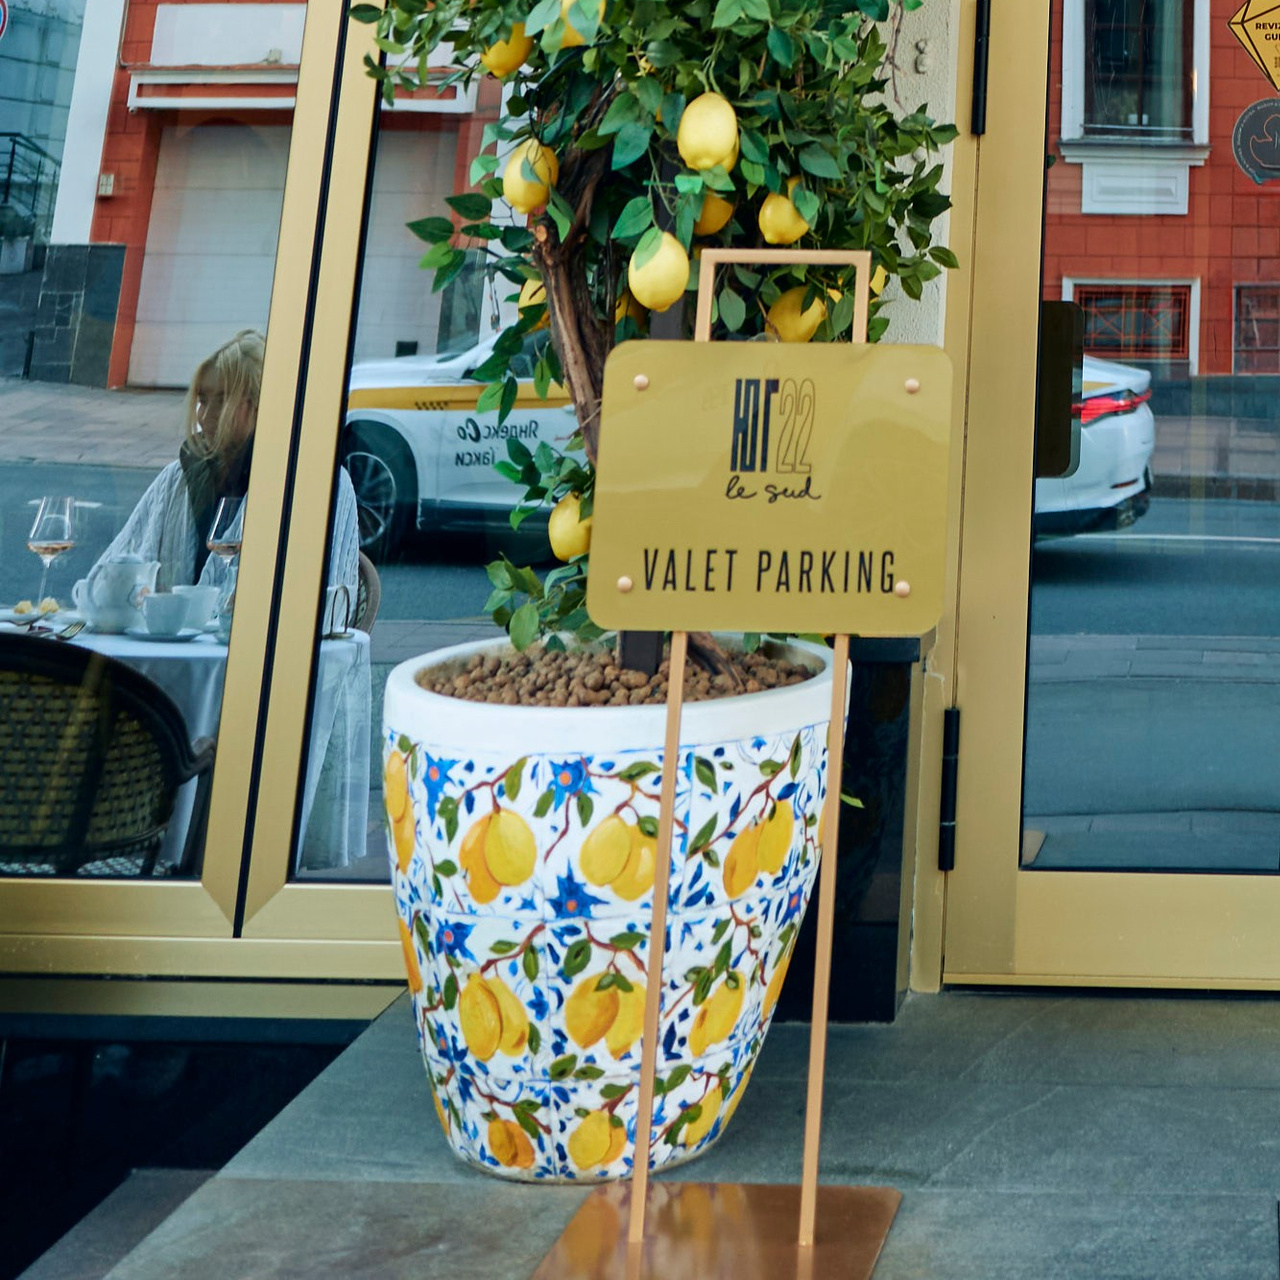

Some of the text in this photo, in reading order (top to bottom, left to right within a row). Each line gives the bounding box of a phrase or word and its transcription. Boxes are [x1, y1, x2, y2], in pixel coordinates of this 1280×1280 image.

[725, 475, 822, 503] le sud
[644, 549, 896, 594] VALET PARKING
